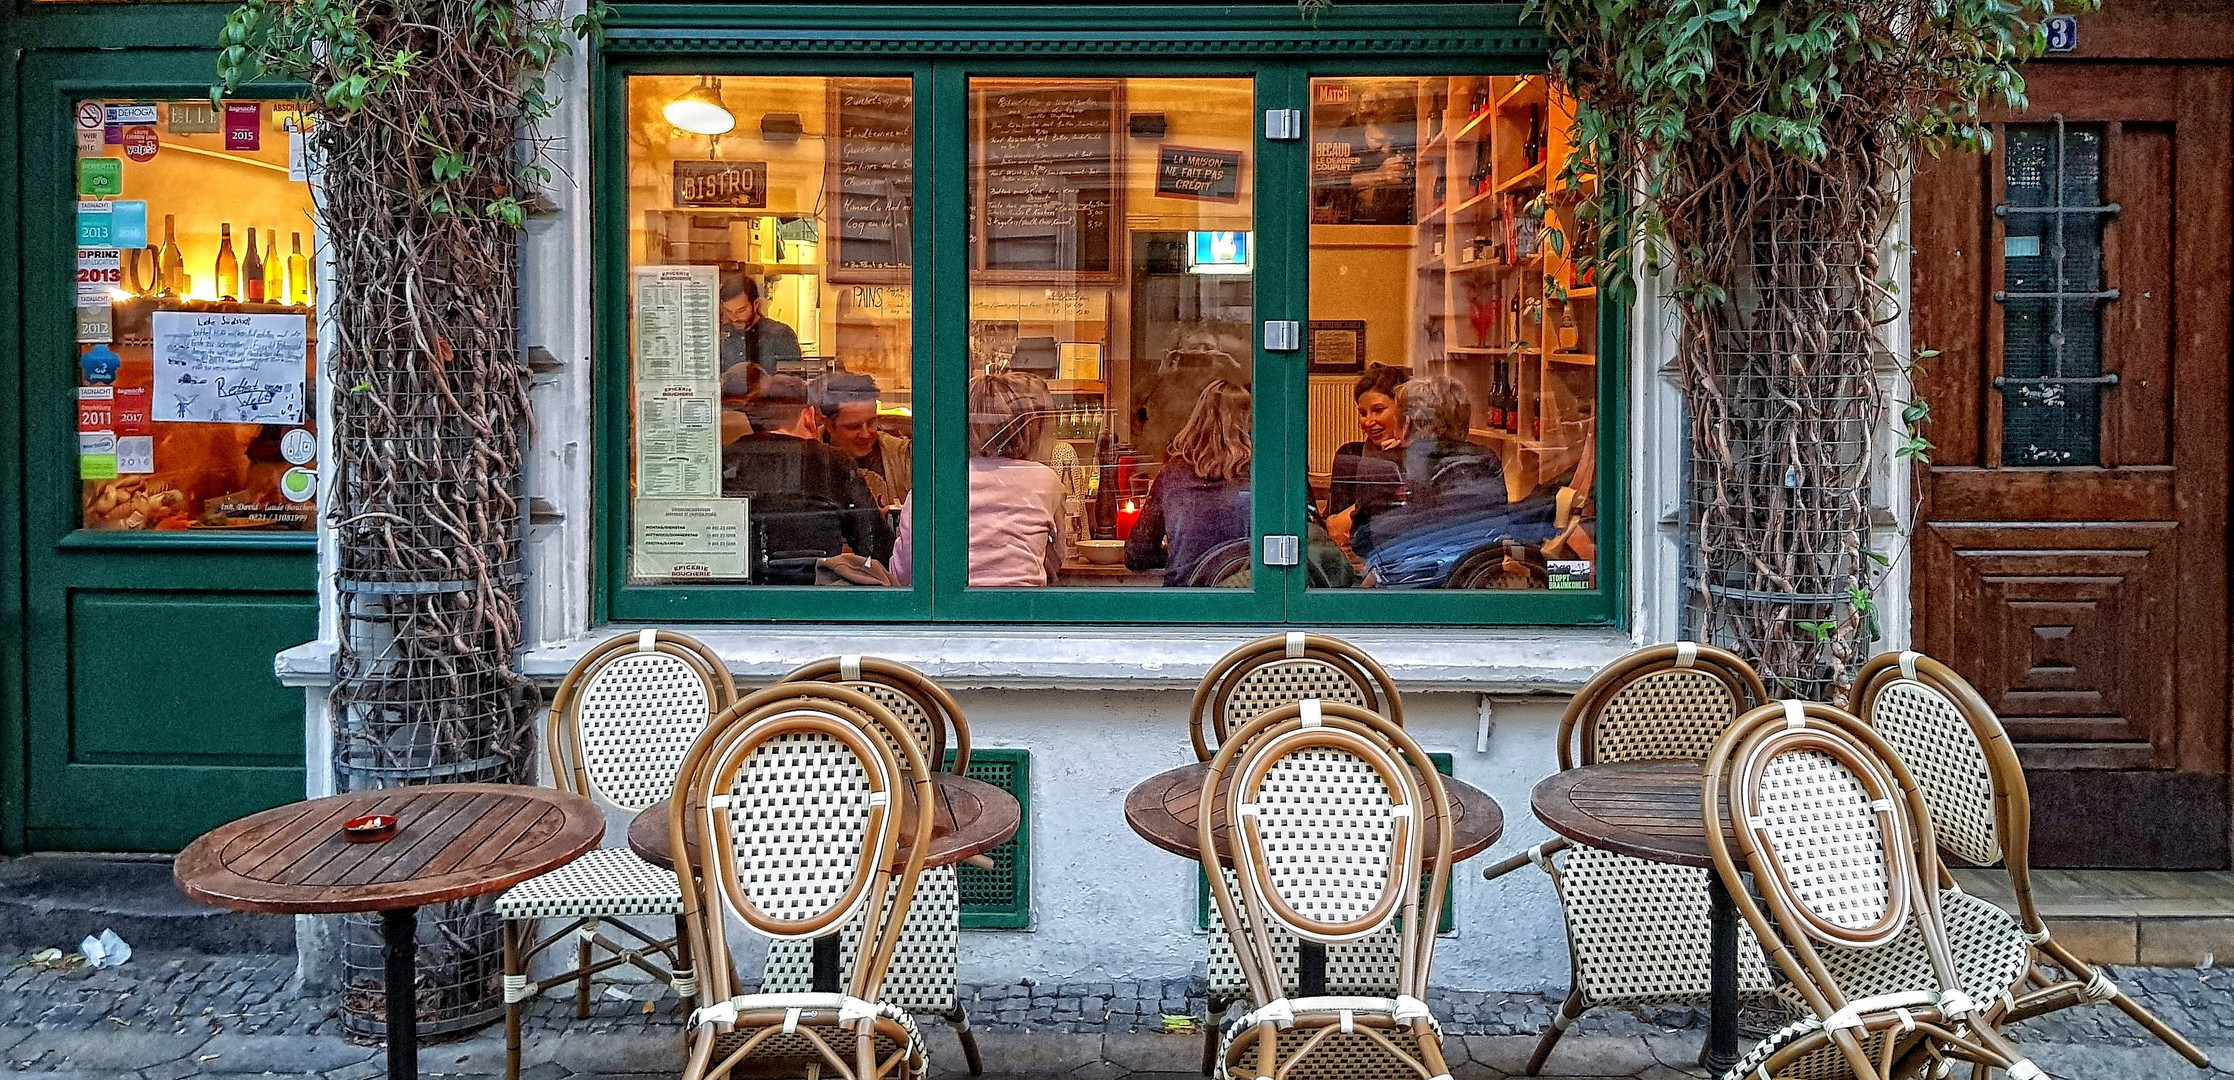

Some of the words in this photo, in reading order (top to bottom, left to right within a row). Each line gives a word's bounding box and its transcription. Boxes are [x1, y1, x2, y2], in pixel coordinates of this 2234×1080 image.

[2052, 19, 2067, 48] 3
[118, 108, 154, 117] DEHOGA
[84, 132, 98, 140] WIR
[232, 131, 254, 141] 2015
[127, 145, 147, 155] yelp
[1173, 155, 1184, 164] LA
[1186, 156, 1223, 168] MAISON
[1326, 157, 1361, 165] DERNIER
[1165, 165, 1179, 176] NE
[1181, 167, 1201, 178] FAIT
[1204, 169, 1224, 181] PAS
[682, 168, 754, 201] BISTRO
[82, 227, 109, 239] 2013
[87, 251, 119, 259] PRINZ
[79, 269, 121, 282] 2013
[853, 286, 884, 308] PAINS
[82, 323, 109, 335] 2012
[82, 411, 112, 426] 2011
[121, 413, 144, 423] 2017
[121, 457, 149, 467] 2016
[236, 503, 259, 511] David
[1548, 574, 1570, 582] STOPPT
[1548, 581, 1589, 590] BRAUNKOHLE!
